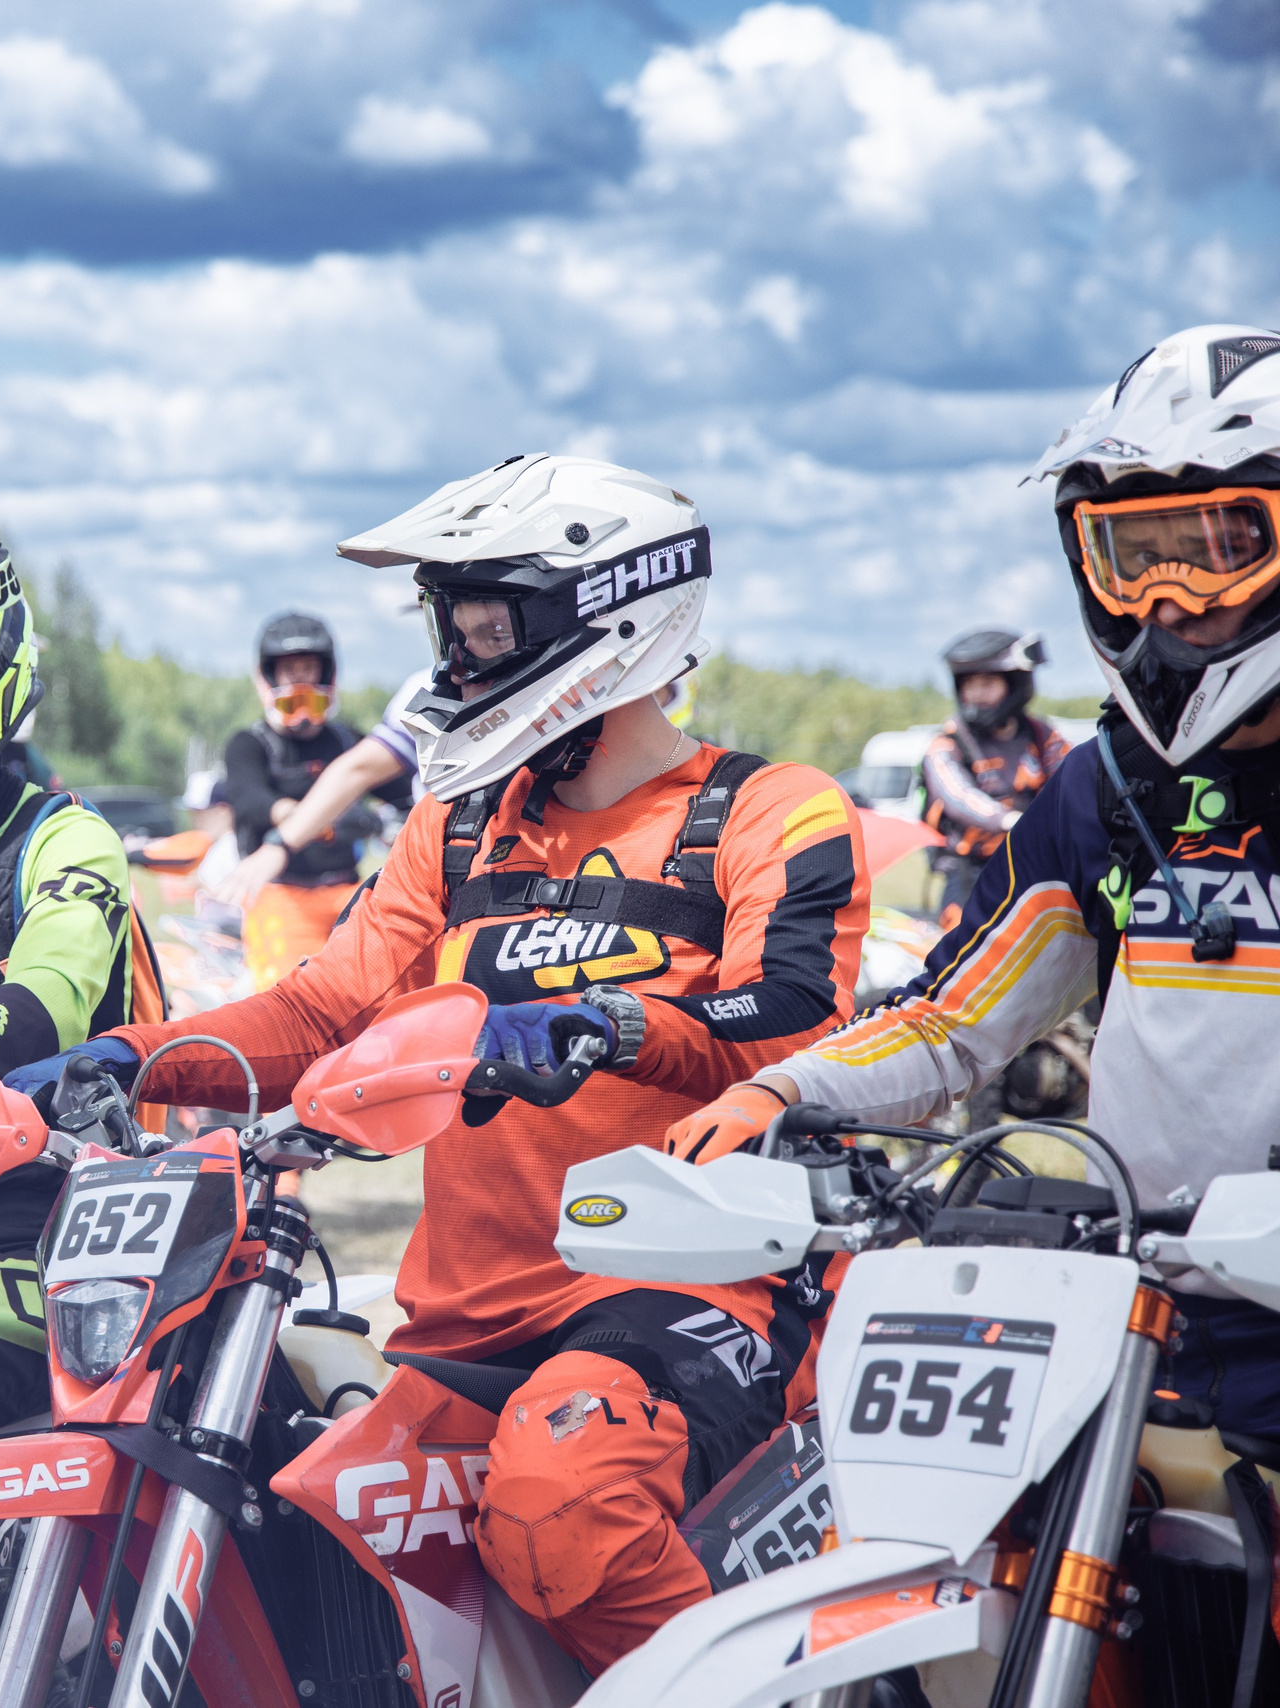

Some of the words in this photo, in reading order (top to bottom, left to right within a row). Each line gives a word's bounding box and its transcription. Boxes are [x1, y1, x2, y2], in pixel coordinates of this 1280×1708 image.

[576, 538, 697, 618] SHOT
[465, 707, 511, 743] 509
[57, 1192, 172, 1261] 652
[572, 1202, 620, 1217] ARC
[849, 1358, 1016, 1447] 654
